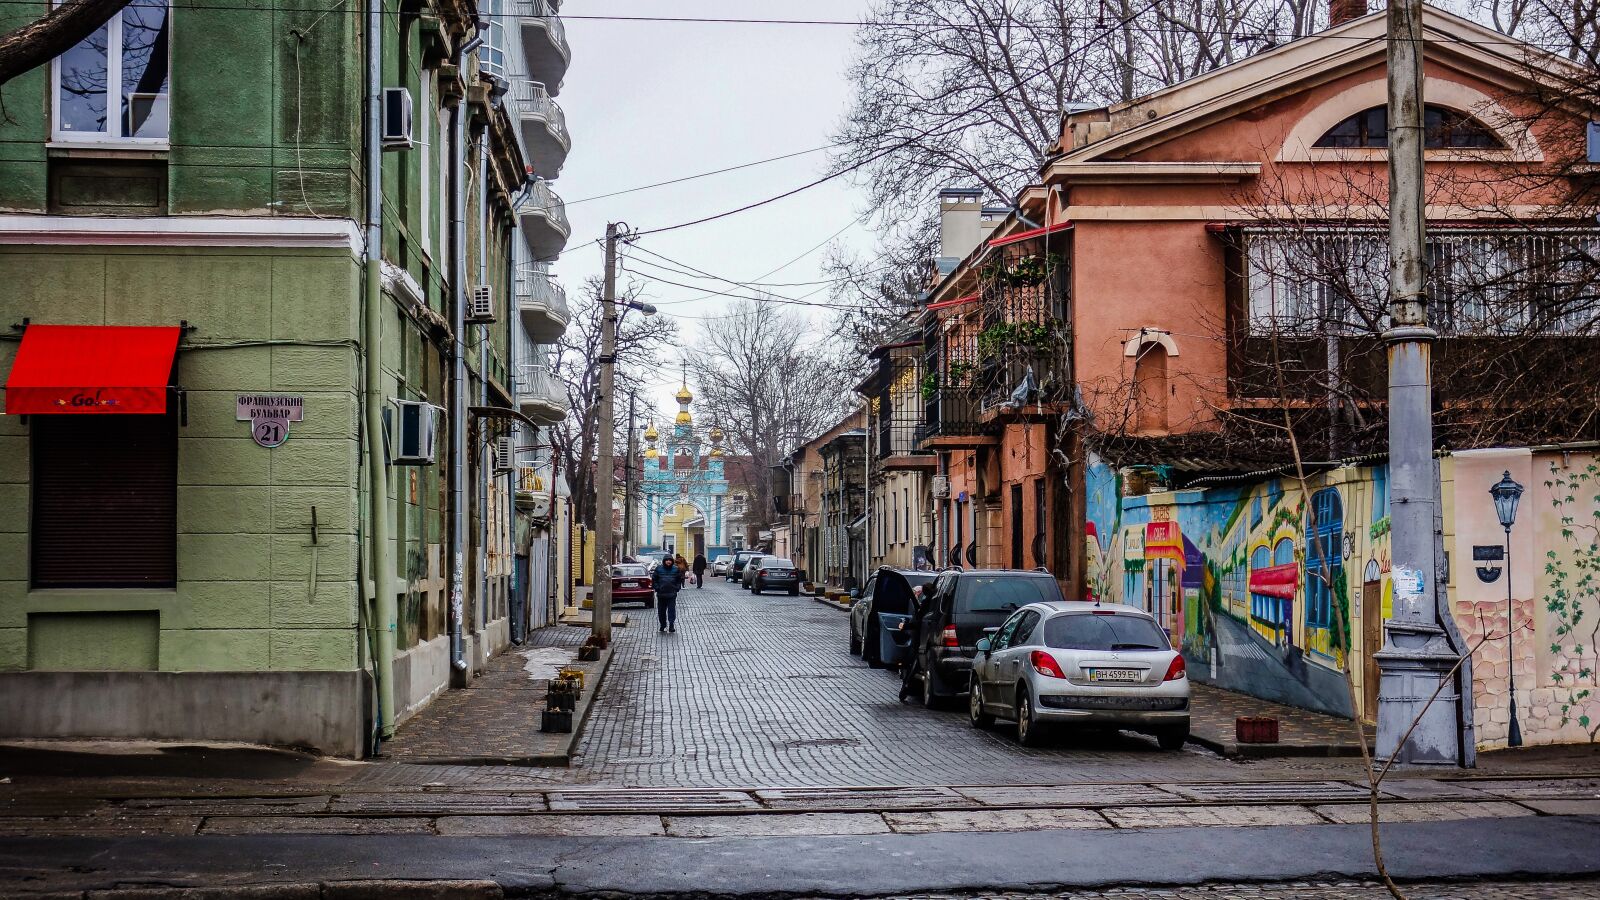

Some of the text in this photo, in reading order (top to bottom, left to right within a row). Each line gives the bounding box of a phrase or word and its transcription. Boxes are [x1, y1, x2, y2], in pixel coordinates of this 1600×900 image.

[71, 390, 101, 407] Go!
[238, 396, 303, 407] ФРАНЦУЗСКИЙ
[250, 408, 290, 418] БУЛЬВАР
[260, 424, 279, 442] 21
[1109, 670, 1127, 679] 4599
